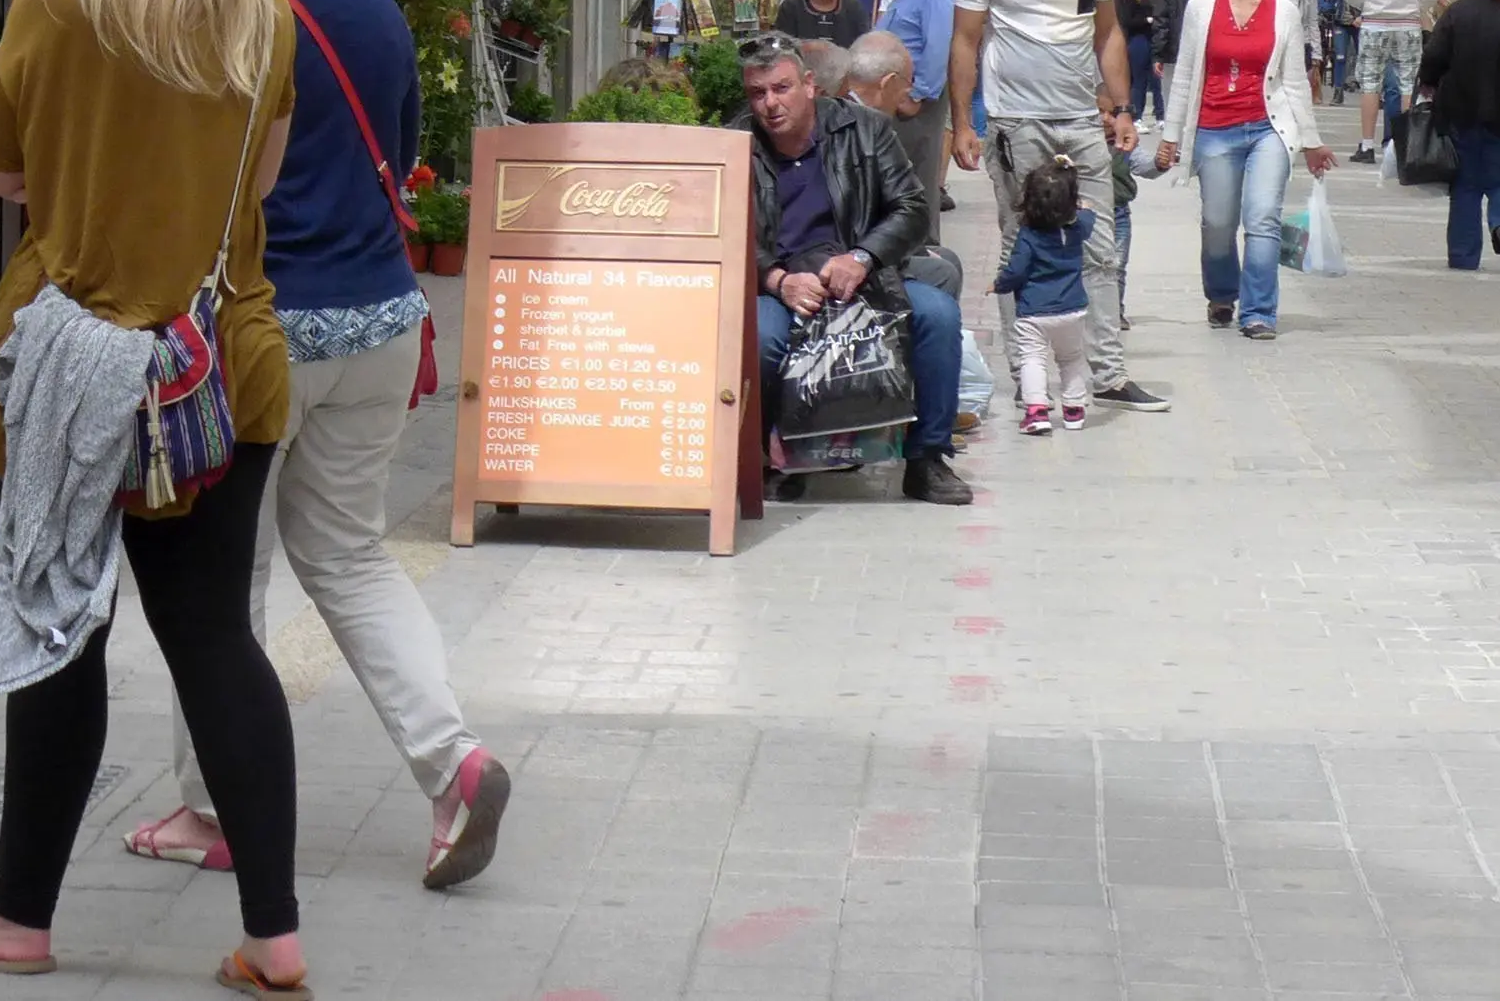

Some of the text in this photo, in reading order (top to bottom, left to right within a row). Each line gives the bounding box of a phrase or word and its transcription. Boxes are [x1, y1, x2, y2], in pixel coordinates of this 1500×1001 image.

[494, 269, 714, 288] All Natural 34 Flavours
[548, 296, 588, 305] cream
[521, 309, 614, 322] Frozen yogurt
[520, 324, 626, 336] sherbet & sorbet
[520, 339, 539, 350] Fat
[547, 340, 576, 351] Free
[584, 341, 609, 352] with
[492, 357, 550, 370] PRICES
[488, 396, 577, 409] MILKSHAKES
[620, 399, 654, 410] From
[488, 412, 534, 424] FRESH
[542, 414, 601, 427] ORANGE
[609, 416, 651, 428] JUICE
[487, 428, 526, 439] COKE
[486, 444, 540, 456] FRAPPE
[485, 459, 534, 472] WATER
